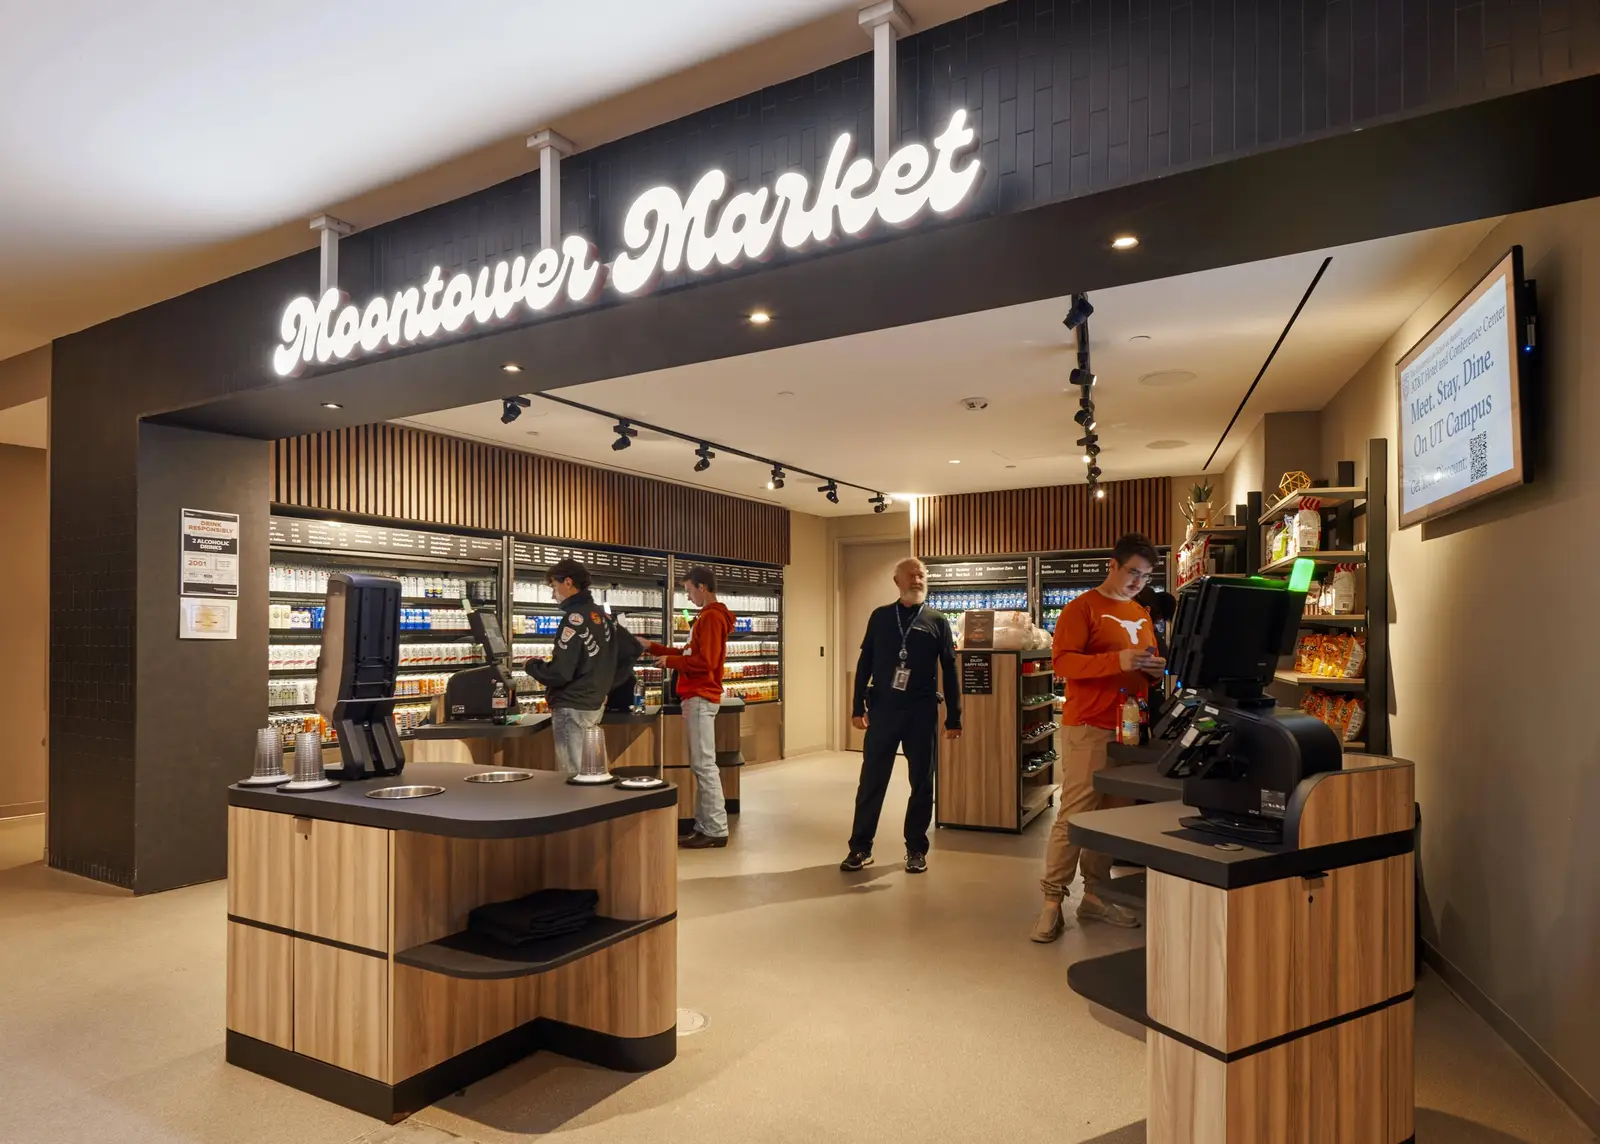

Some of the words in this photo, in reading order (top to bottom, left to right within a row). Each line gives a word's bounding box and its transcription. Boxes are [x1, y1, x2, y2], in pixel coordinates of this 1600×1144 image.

[273, 235, 600, 377] Moontower
[611, 107, 982, 295] Market
[1448, 324, 1482, 361] Conference
[1482, 305, 1506, 332] Center
[1410, 393, 1436, 424] Meet.
[1436, 374, 1462, 406] Stay.
[1463, 350, 1494, 386] Dine.
[1413, 434, 1428, 457] On
[1429, 418, 1444, 448] UT
[1446, 394, 1492, 437] Campus
[188, 525, 233, 533] RESPONSIBLY
[197, 538, 230, 546] ALCOHOLIC
